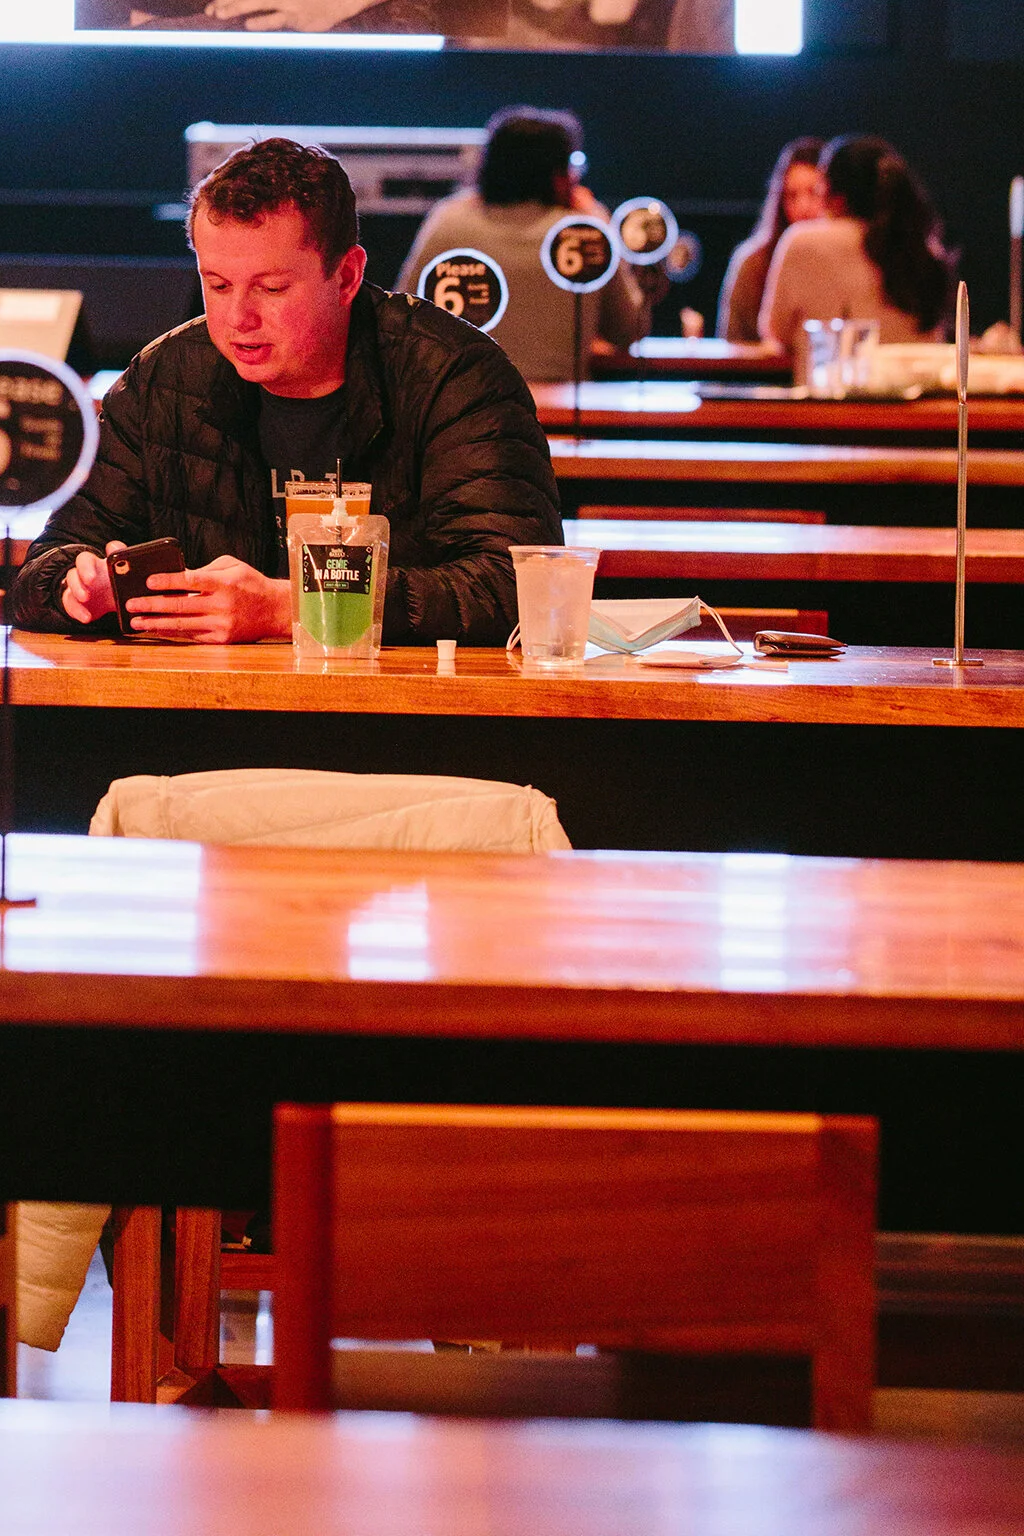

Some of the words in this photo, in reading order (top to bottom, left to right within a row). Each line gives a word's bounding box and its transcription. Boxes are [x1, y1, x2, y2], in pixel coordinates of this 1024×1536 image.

[556, 237, 584, 276] 6
[436, 261, 486, 278] Please
[434, 277, 465, 316] 6
[326, 559, 349, 570] GENIE
[323, 570, 330, 580] A
[330, 570, 360, 581] BOTTLE
